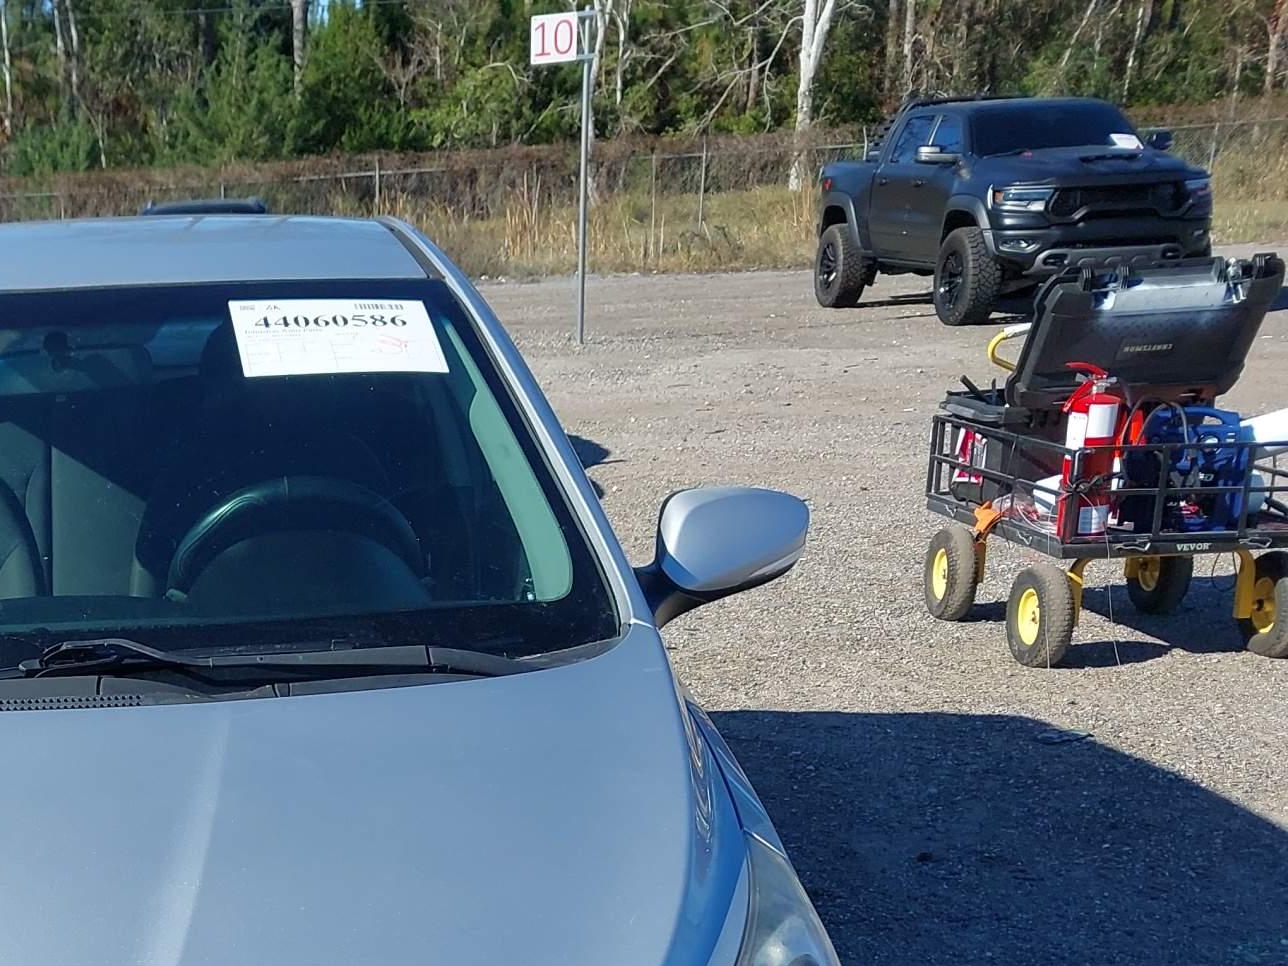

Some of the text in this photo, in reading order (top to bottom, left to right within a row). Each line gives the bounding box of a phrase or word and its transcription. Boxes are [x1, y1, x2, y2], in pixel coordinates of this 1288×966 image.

[534, 19, 573, 57] 10
[254, 314, 408, 329] 44060586
[1176, 543, 1211, 552] VEVOR
